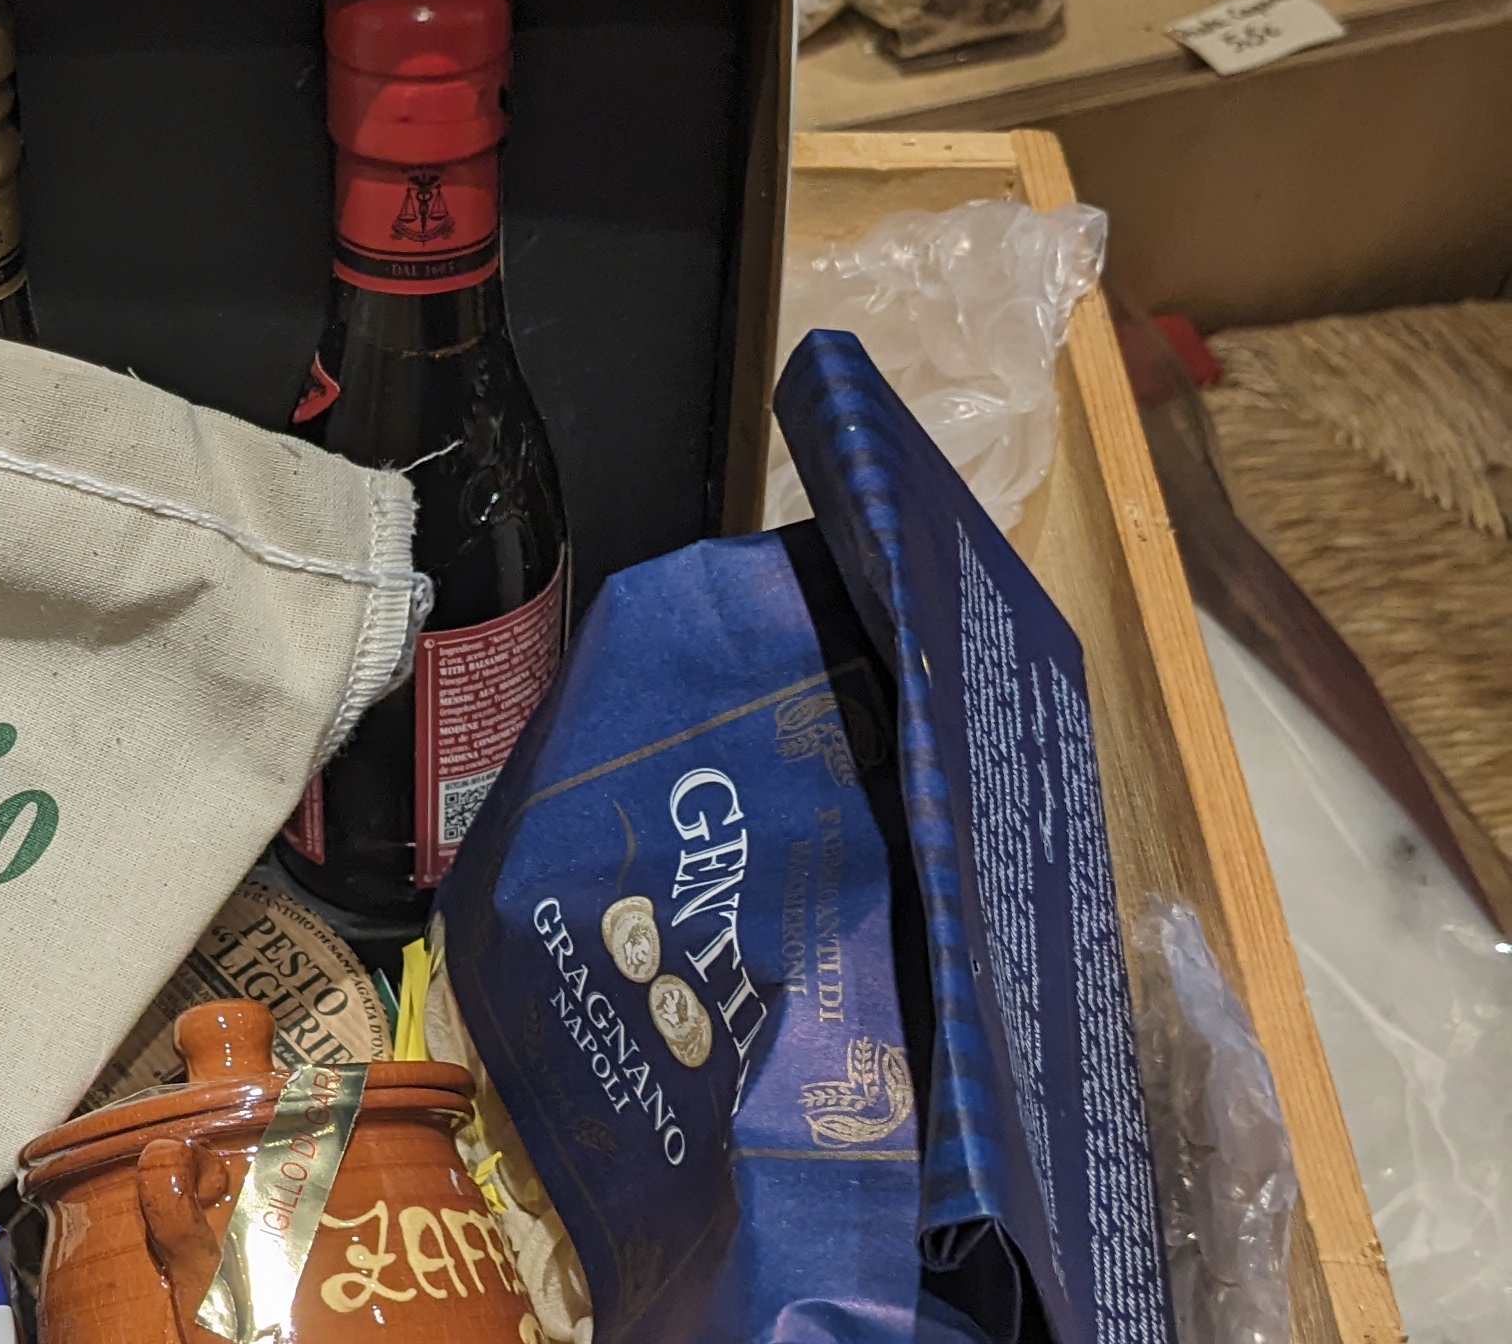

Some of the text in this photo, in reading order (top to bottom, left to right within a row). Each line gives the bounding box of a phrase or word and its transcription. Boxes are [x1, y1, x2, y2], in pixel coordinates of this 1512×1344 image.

[237, 908, 353, 1024] PESTO
[669, 766, 770, 1118] GENTIL
[818, 981, 842, 1024] DI
[533, 897, 686, 1166] GRAGNANO
[549, 988, 632, 1116] NAPOLI
[257, 1157, 310, 1241] IGILLO
